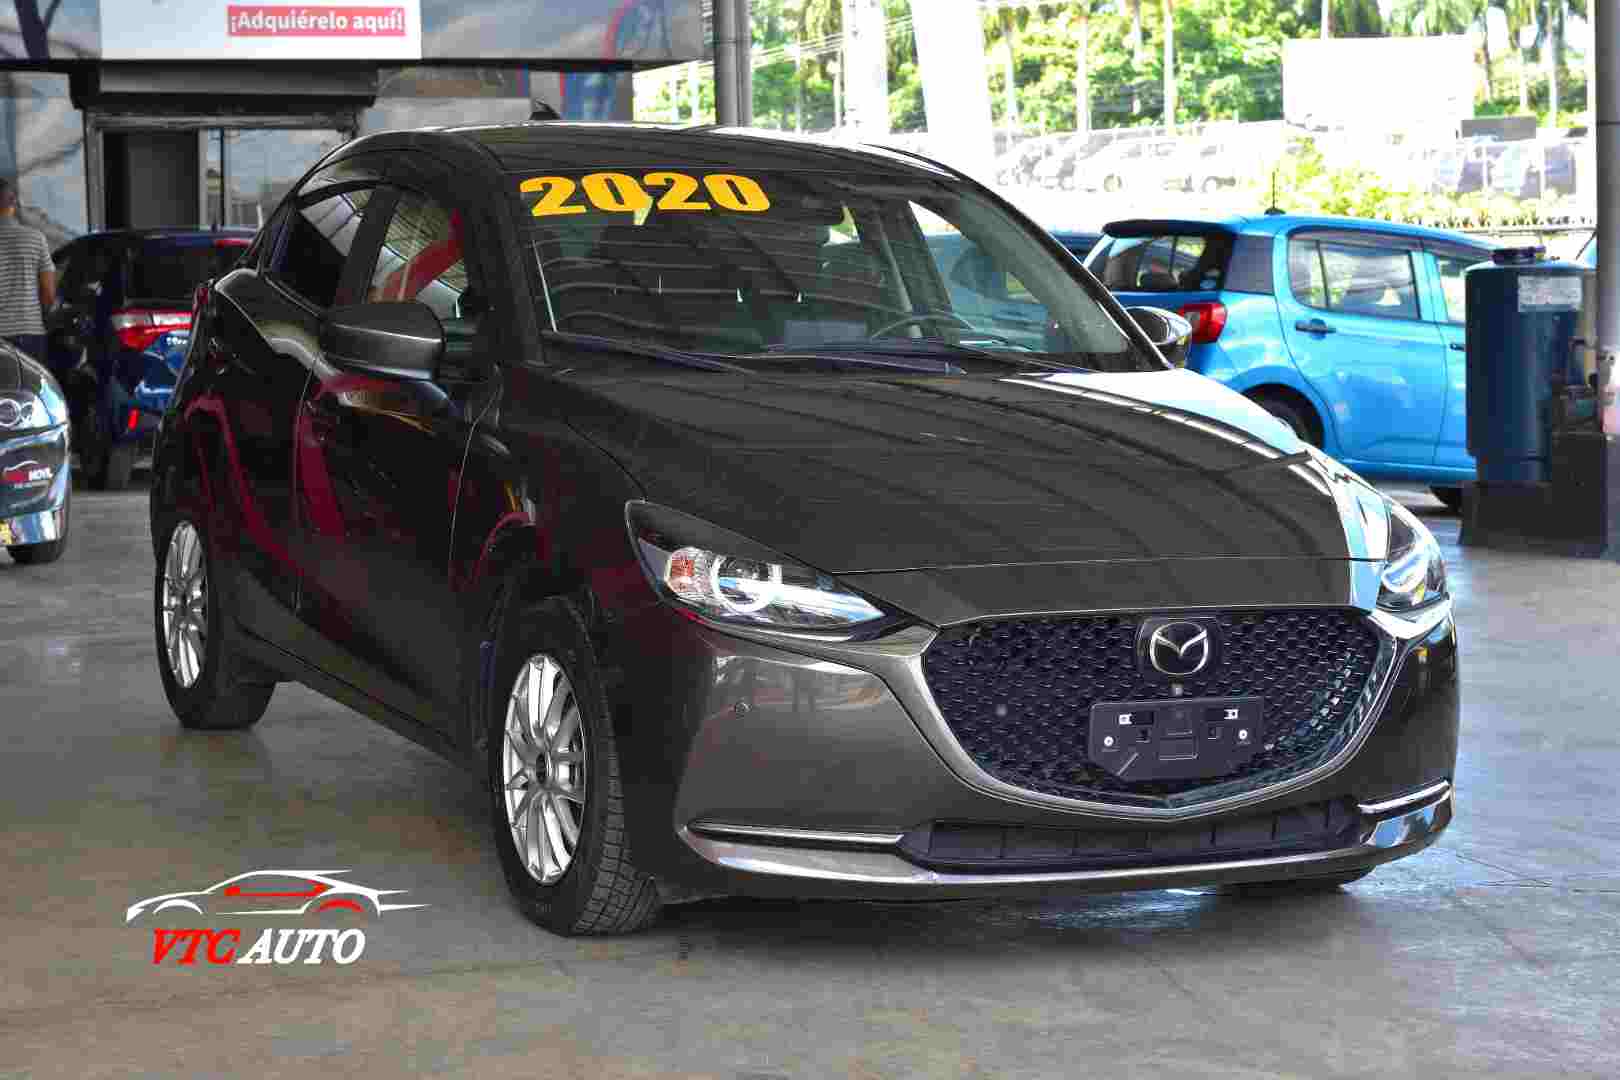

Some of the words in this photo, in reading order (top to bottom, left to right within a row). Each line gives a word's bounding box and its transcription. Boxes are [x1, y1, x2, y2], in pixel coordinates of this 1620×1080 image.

[231, 9, 348, 33] ¡Adquiérelo
[353, 9, 403, 33] aquí!
[519, 172, 769, 217] 2020
